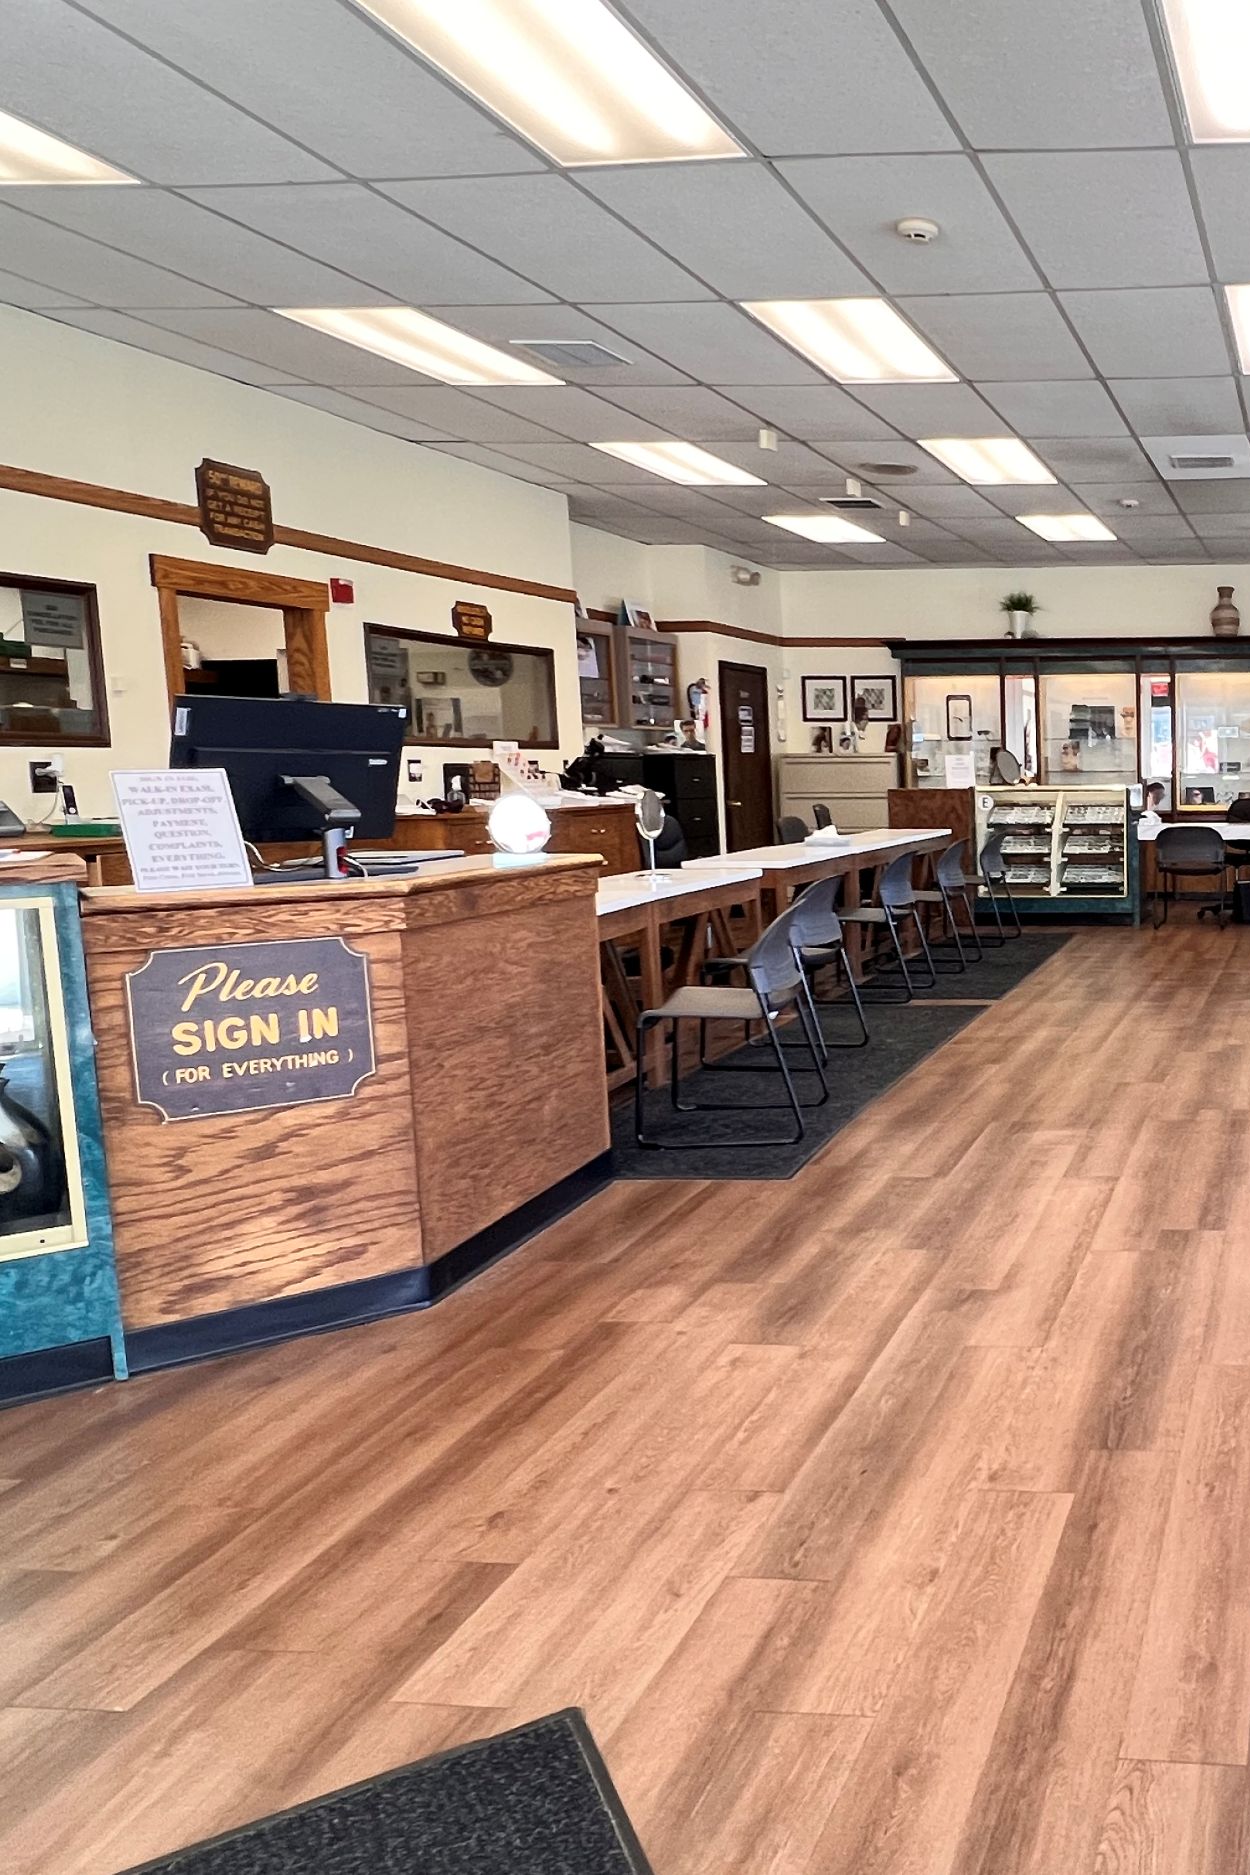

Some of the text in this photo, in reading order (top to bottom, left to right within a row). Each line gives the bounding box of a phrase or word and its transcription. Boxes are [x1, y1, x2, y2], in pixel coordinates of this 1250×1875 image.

[982, 796, 989, 809] E
[178, 961, 319, 1012] Please
[171, 1006, 339, 1056] SIGN IN
